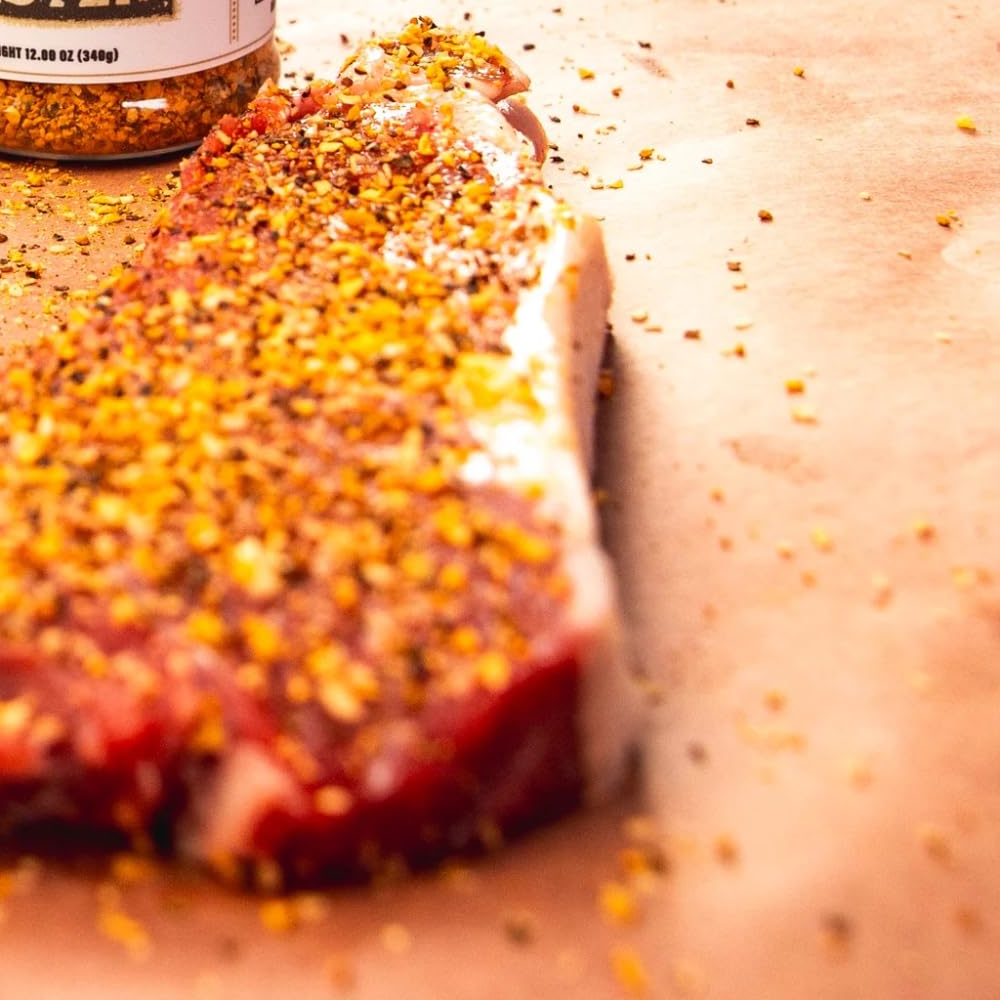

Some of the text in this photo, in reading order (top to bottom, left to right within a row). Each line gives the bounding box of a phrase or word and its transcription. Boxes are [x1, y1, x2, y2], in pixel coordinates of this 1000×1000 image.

[25, 48, 56, 62] 12.00
[59, 50, 74, 62] OZ
[77, 48, 119, 64] (340g)
